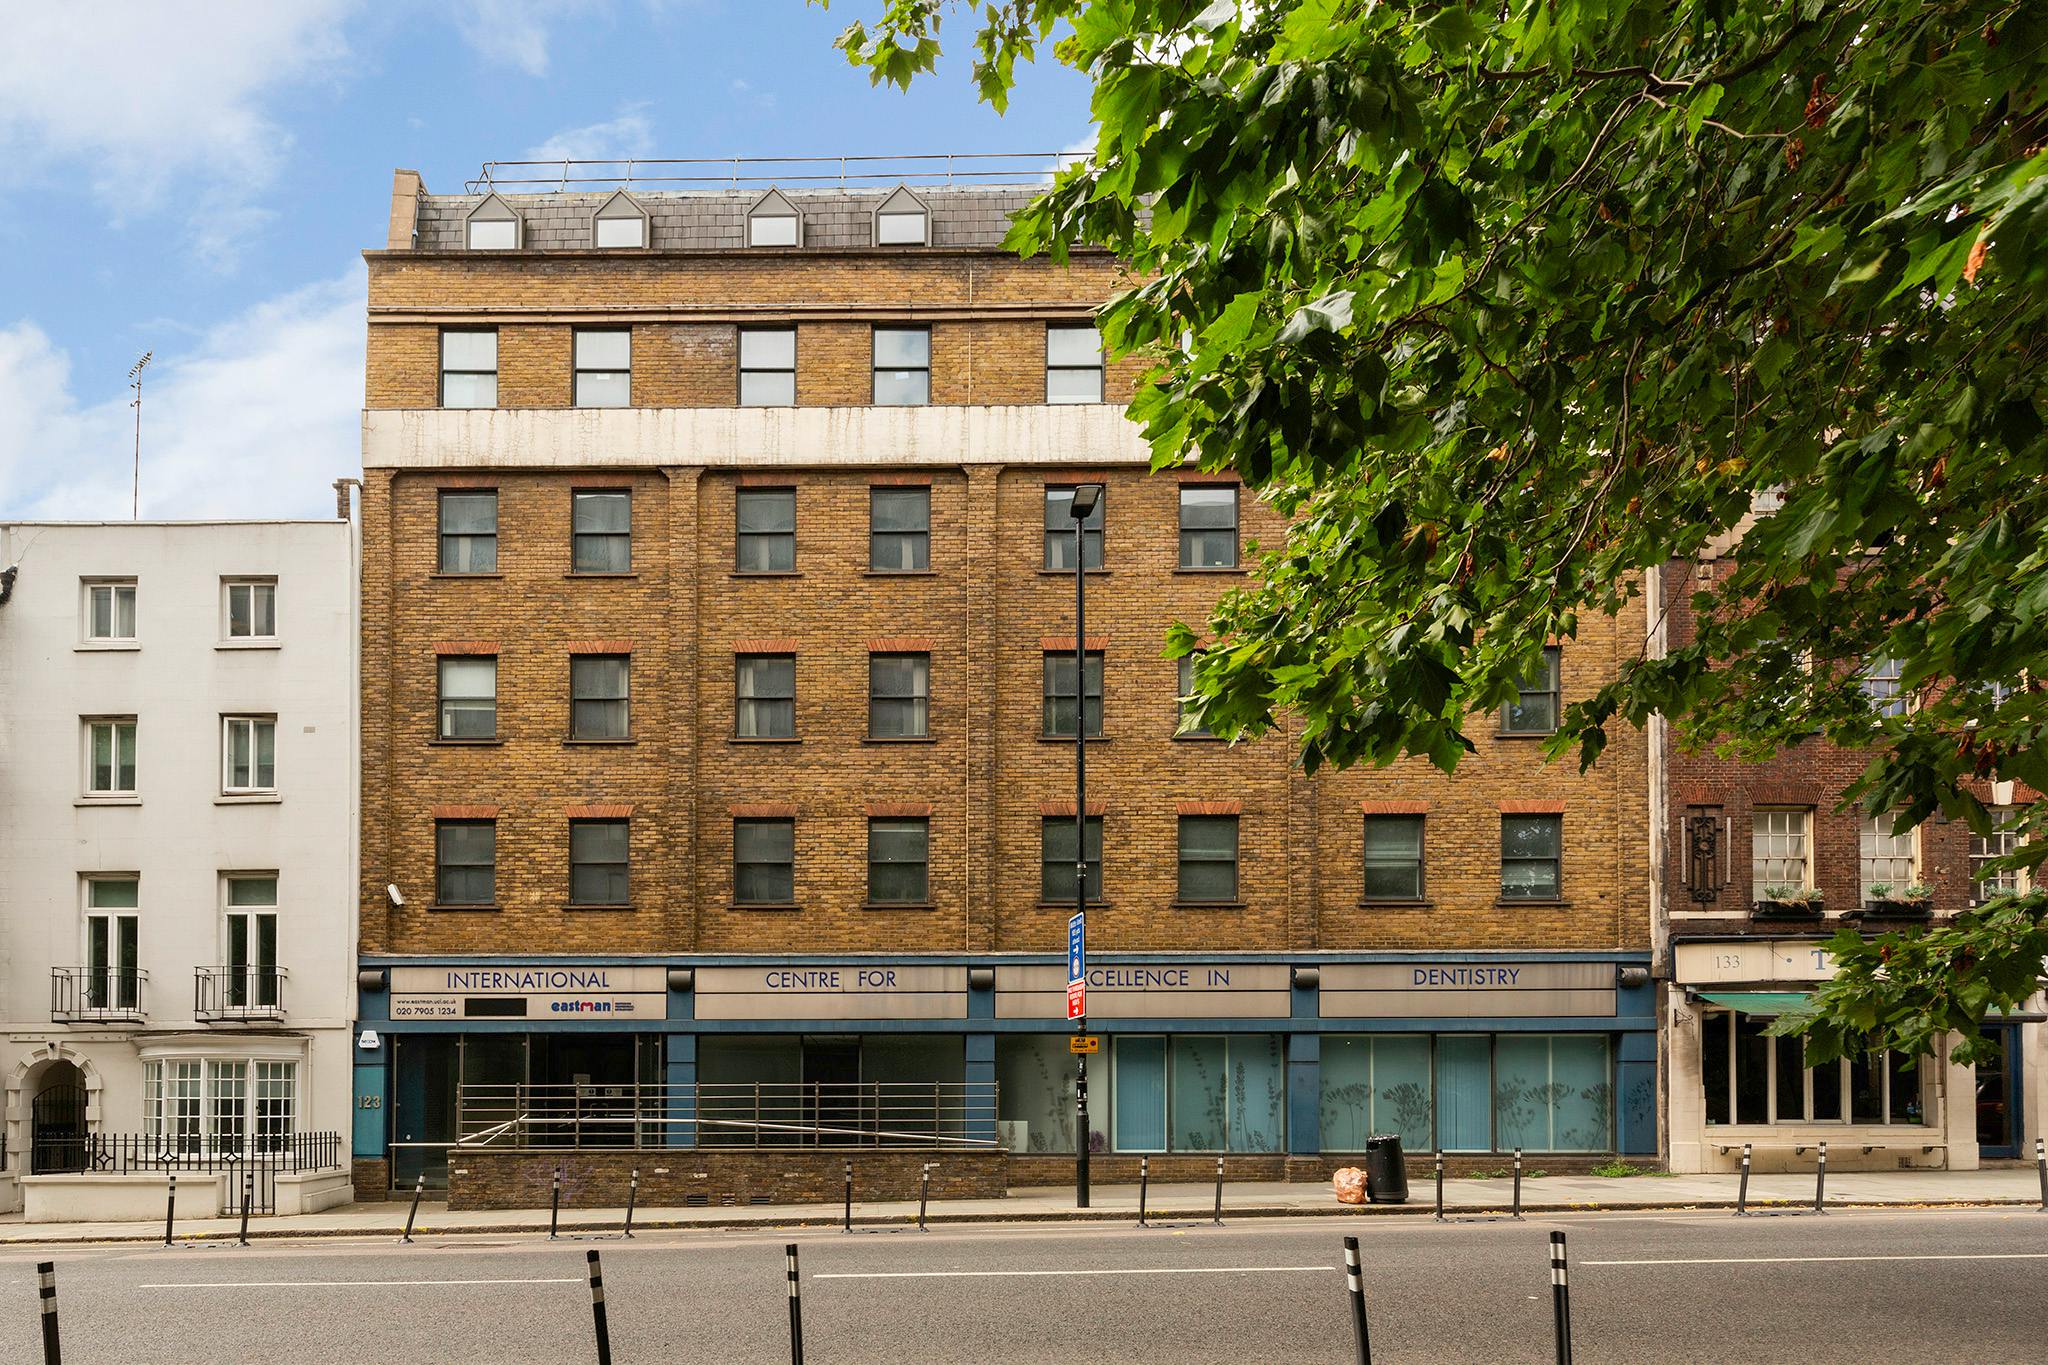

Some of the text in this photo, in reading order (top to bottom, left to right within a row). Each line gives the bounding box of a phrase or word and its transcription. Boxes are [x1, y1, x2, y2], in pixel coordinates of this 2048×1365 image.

[1715, 955, 1740, 969] 133
[447, 970, 609, 989] INTERNATIONAL
[766, 971, 896, 988] CENTRE FOR
[1084, 970, 1229, 987] CELLENCE IN
[1414, 968, 1520, 985] DENTISTRY
[396, 1007, 456, 1015] 020 7905 1234
[551, 1000, 611, 1012] eastman
[358, 1095, 382, 1109] 123
